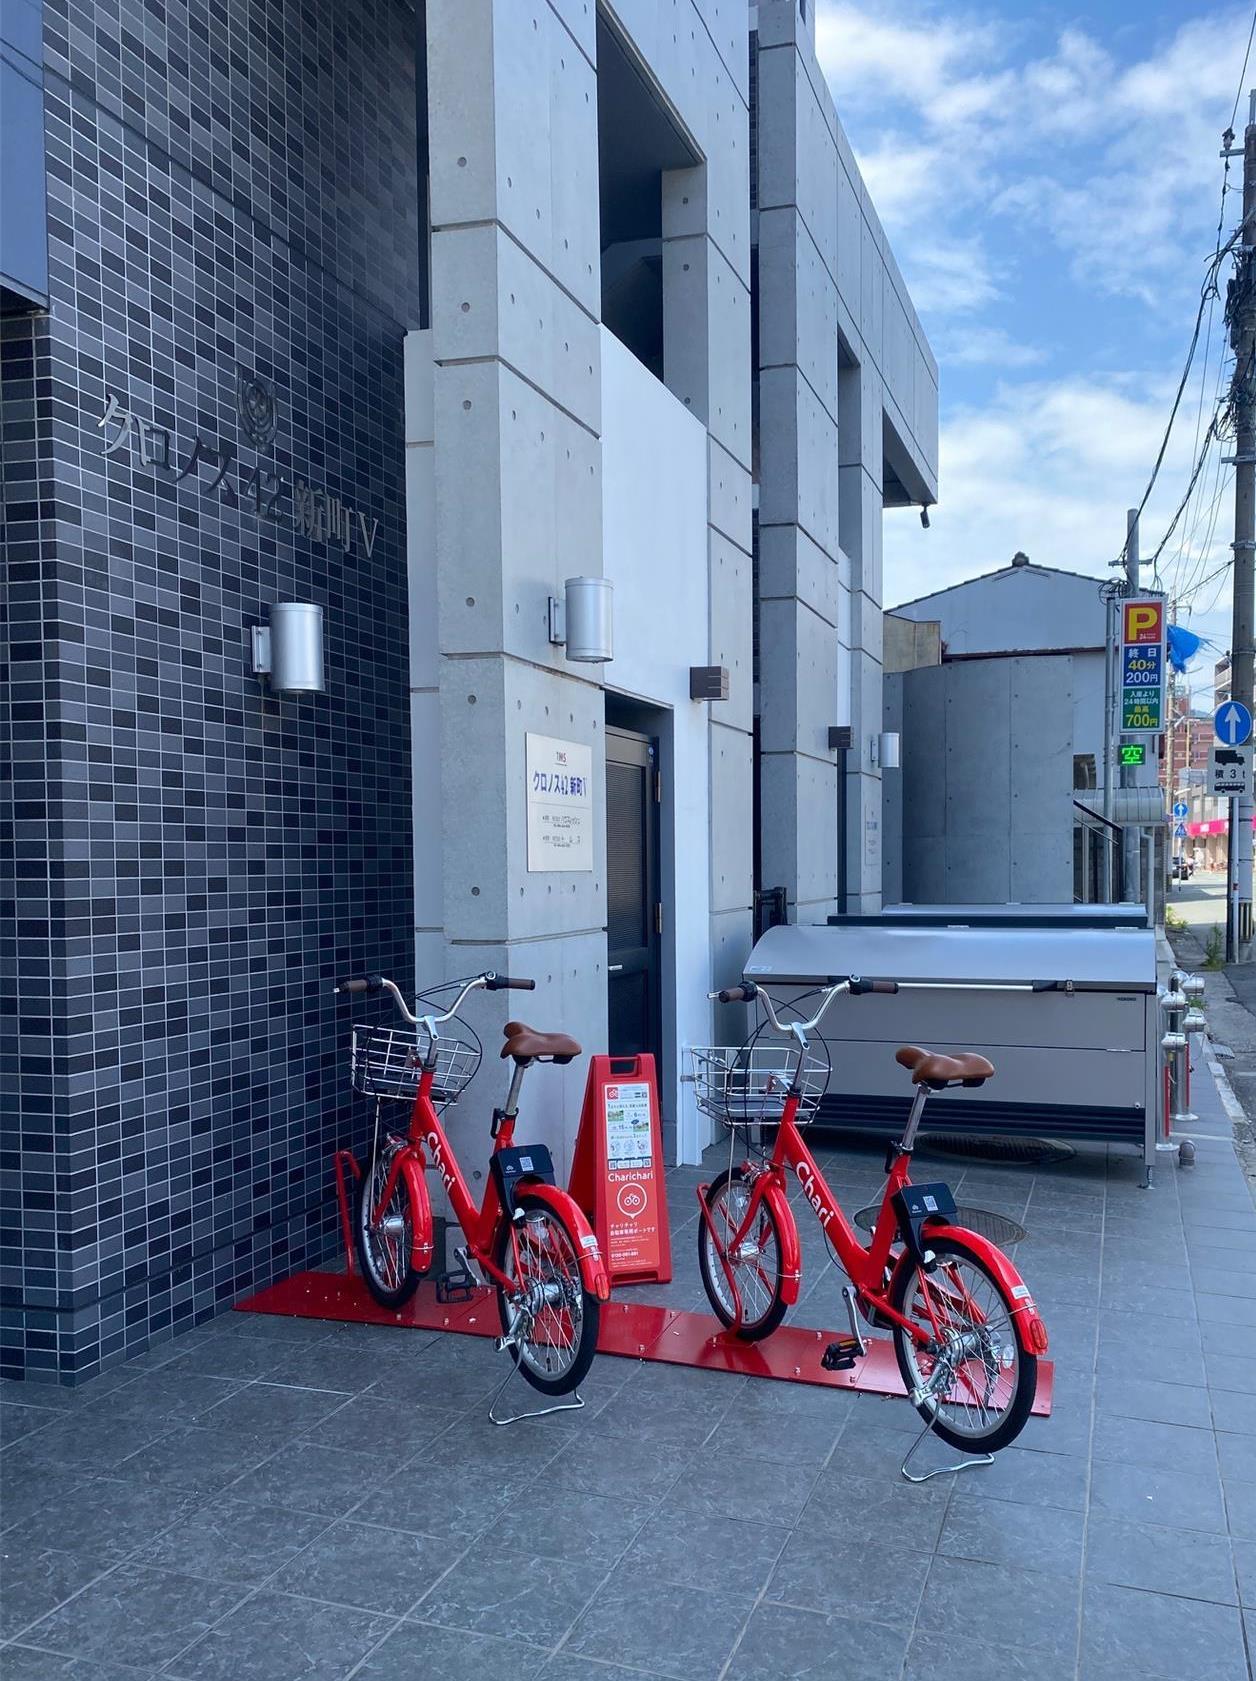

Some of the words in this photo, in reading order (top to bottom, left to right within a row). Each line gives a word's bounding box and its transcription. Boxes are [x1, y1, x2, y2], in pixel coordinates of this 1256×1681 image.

[1128, 607, 1158, 641] P
[1128, 647, 1157, 659] 終日
[1128, 659, 1157, 670] 40分
[1126, 671, 1159, 684] 200円
[1126, 714, 1158, 727] 700円
[1121, 745, 1143, 765] 空
[426, 1131, 456, 1193] Chari
[608, 1170, 654, 1182] Charichari
[796, 1161, 835, 1228] Chari
